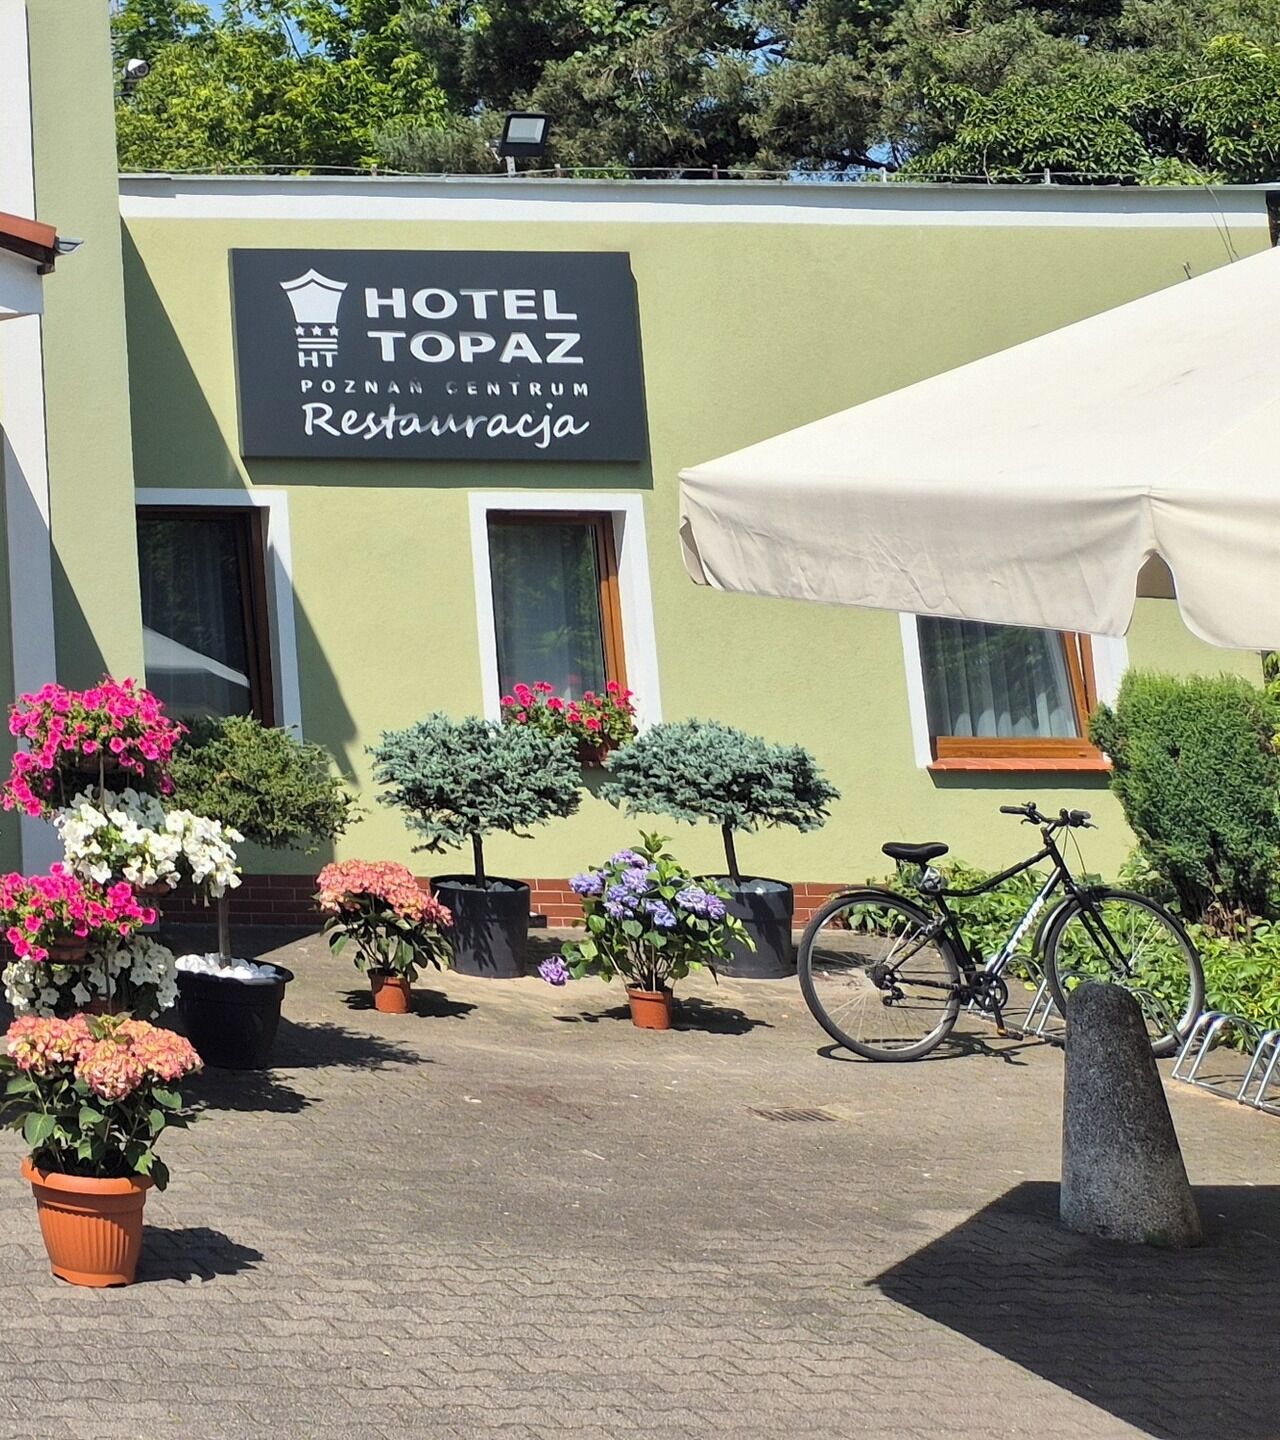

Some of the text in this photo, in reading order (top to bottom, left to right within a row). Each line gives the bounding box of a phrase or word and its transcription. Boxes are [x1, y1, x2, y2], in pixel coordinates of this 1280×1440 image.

[364, 287, 578, 321] HOTEL
[298, 351, 338, 368] HT
[366, 329, 584, 364] TOPAZ
[446, 380, 589, 396] CENTRUM
[301, 402, 590, 449] Restauracja
